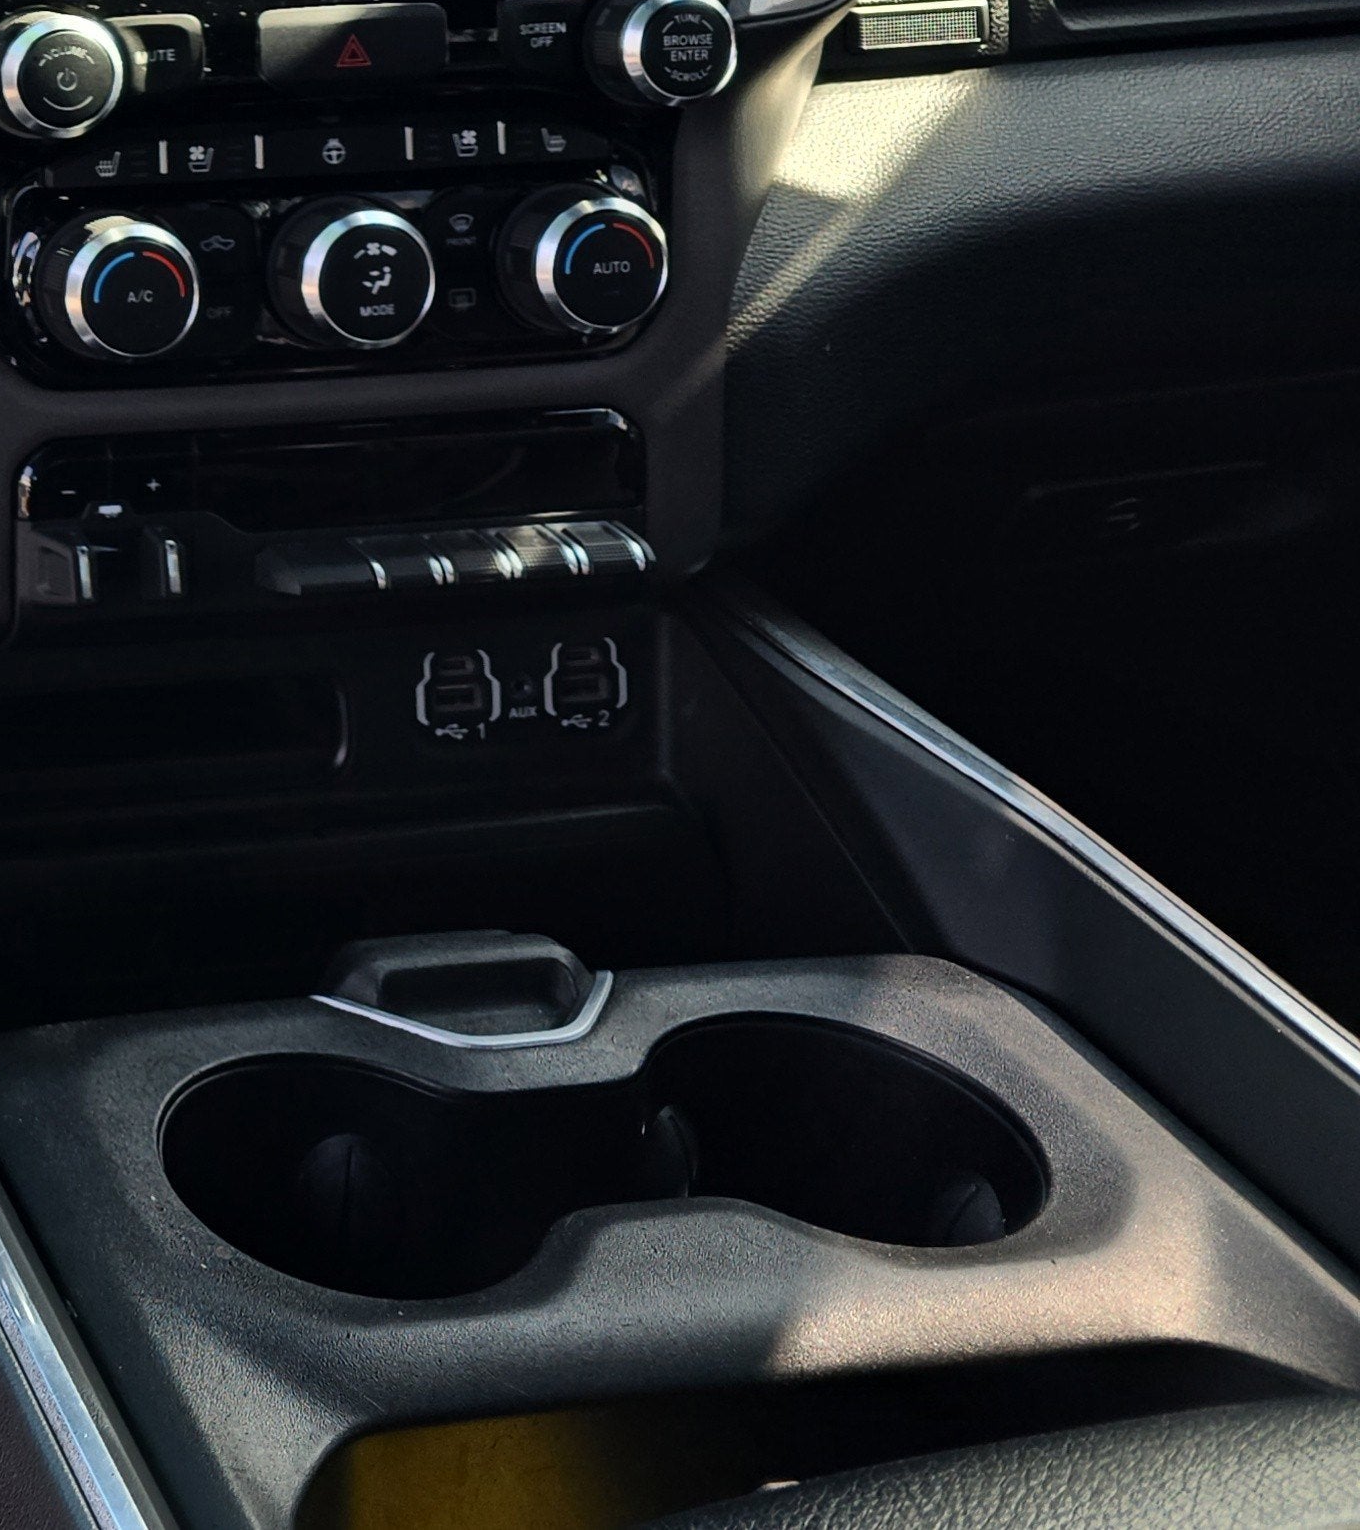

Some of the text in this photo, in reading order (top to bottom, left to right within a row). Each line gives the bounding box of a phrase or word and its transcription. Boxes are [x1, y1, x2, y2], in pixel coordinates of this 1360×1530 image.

[674, 14, 702, 24] TUNE
[520, 22, 567, 36] SCREEN
[531, 36, 553, 49] OFF
[663, 32, 713, 47] BROWSE
[670, 49, 709, 62] ENTER
[670, 69, 708, 82] SCROLL
[592, 260, 630, 275] AUTO
[127, 290, 154, 304] A/C
[359, 303, 396, 317] MODE
[508, 705, 538, 719] AUX
